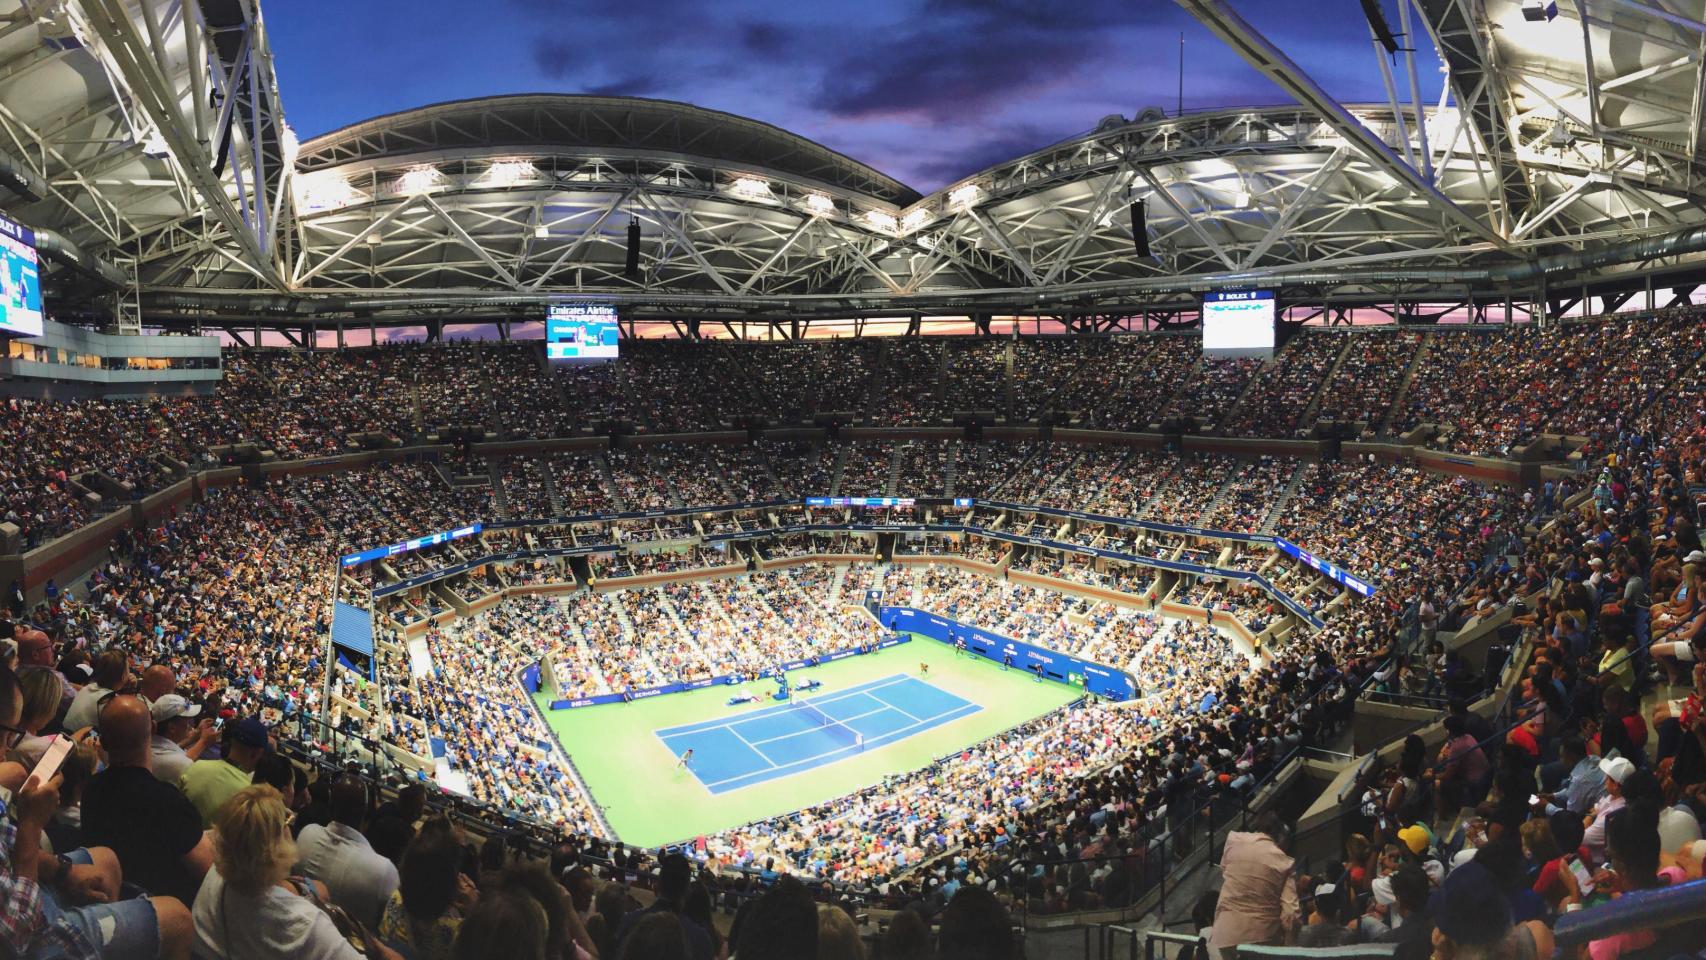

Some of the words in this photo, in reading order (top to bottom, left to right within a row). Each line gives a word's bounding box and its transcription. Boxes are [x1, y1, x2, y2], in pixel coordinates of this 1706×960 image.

[551, 306, 585, 315] Emirates
[586, 306, 614, 315] Airline
[634, 690, 661, 698] BERMUDA
